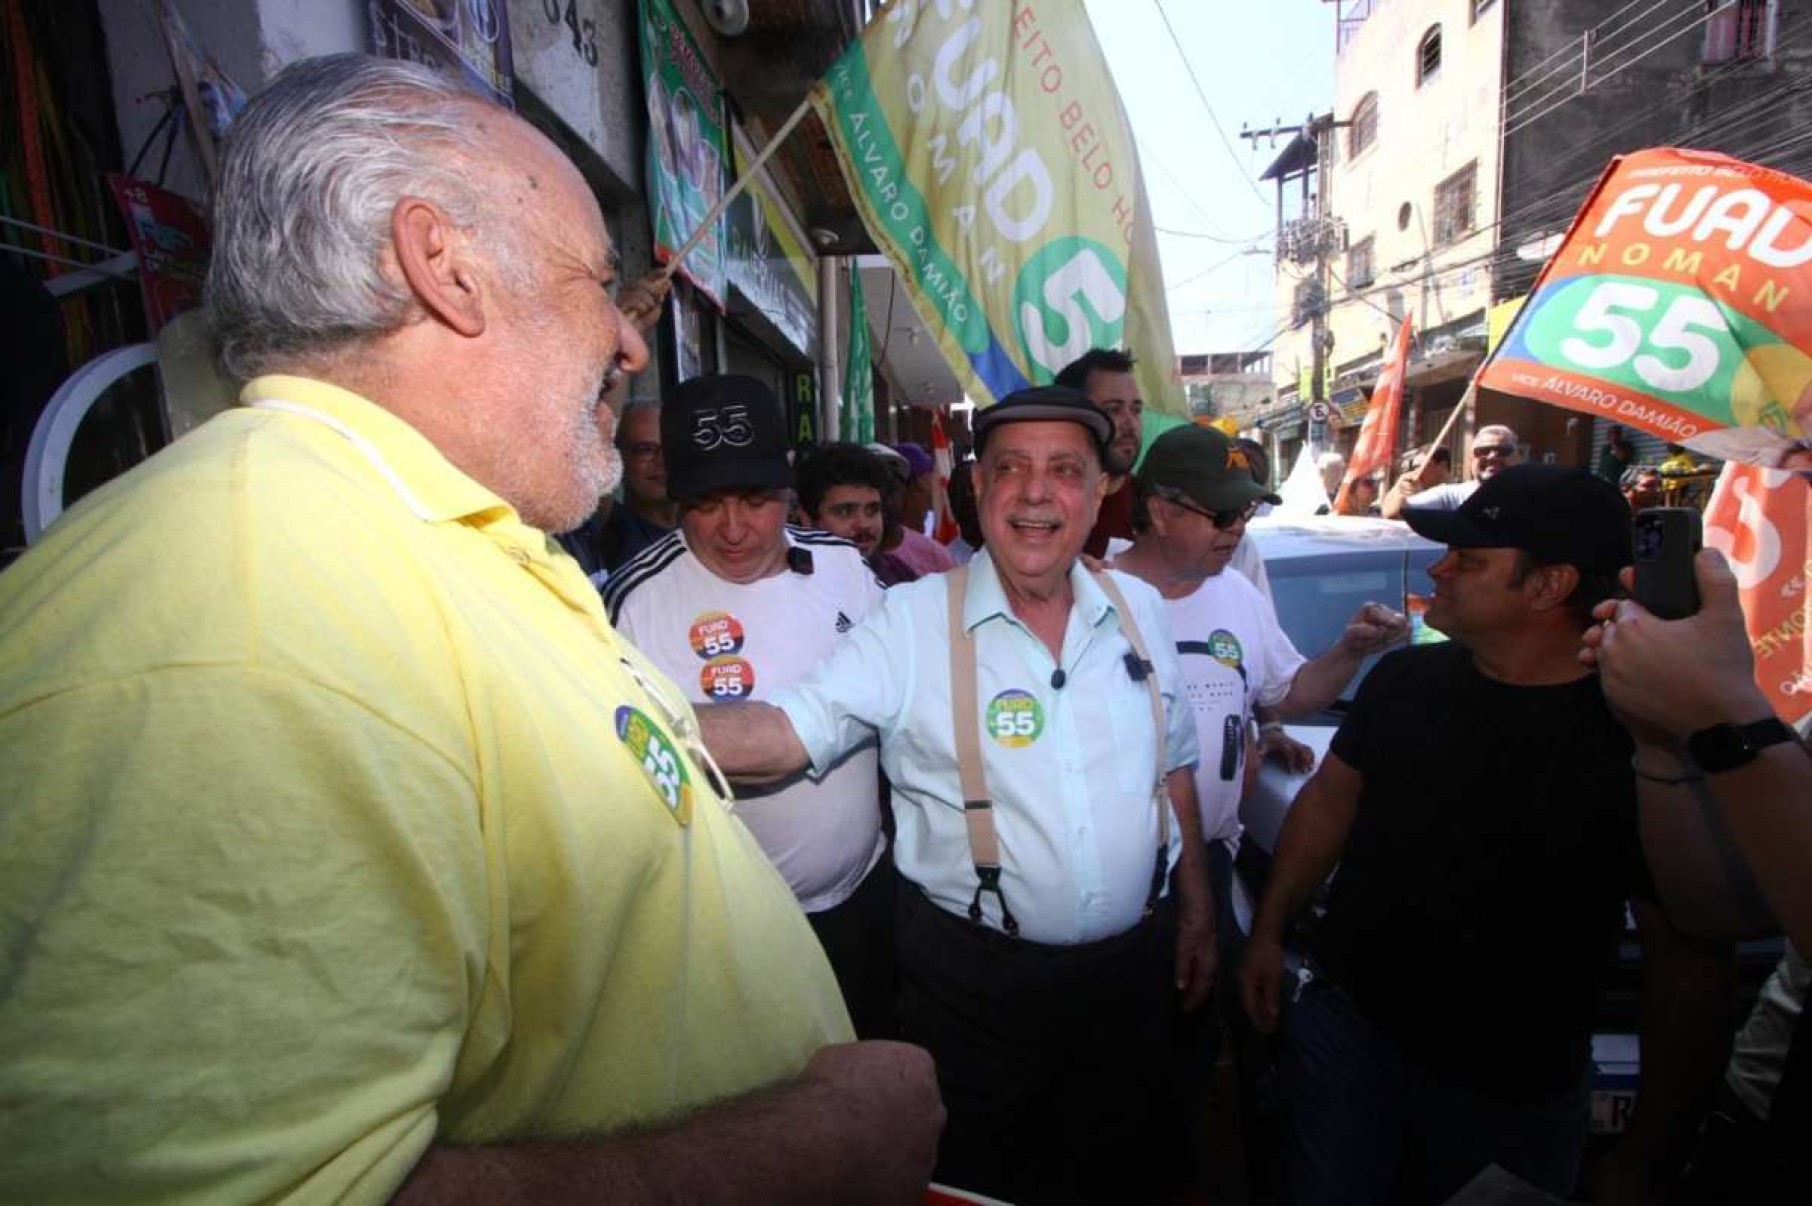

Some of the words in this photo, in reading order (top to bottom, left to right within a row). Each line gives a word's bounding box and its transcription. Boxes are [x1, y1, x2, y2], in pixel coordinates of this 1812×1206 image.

[1060, 100, 1112, 189] BELO
[1020, 248, 1127, 376] 5
[1577, 242, 1789, 313] NOMAN
[1558, 282, 1729, 392] 55
[693, 404, 752, 450] 55
[704, 633, 735, 655] 55
[713, 678, 743, 696] 55
[996, 711, 1035, 736] 55
[639, 731, 681, 808] 55
